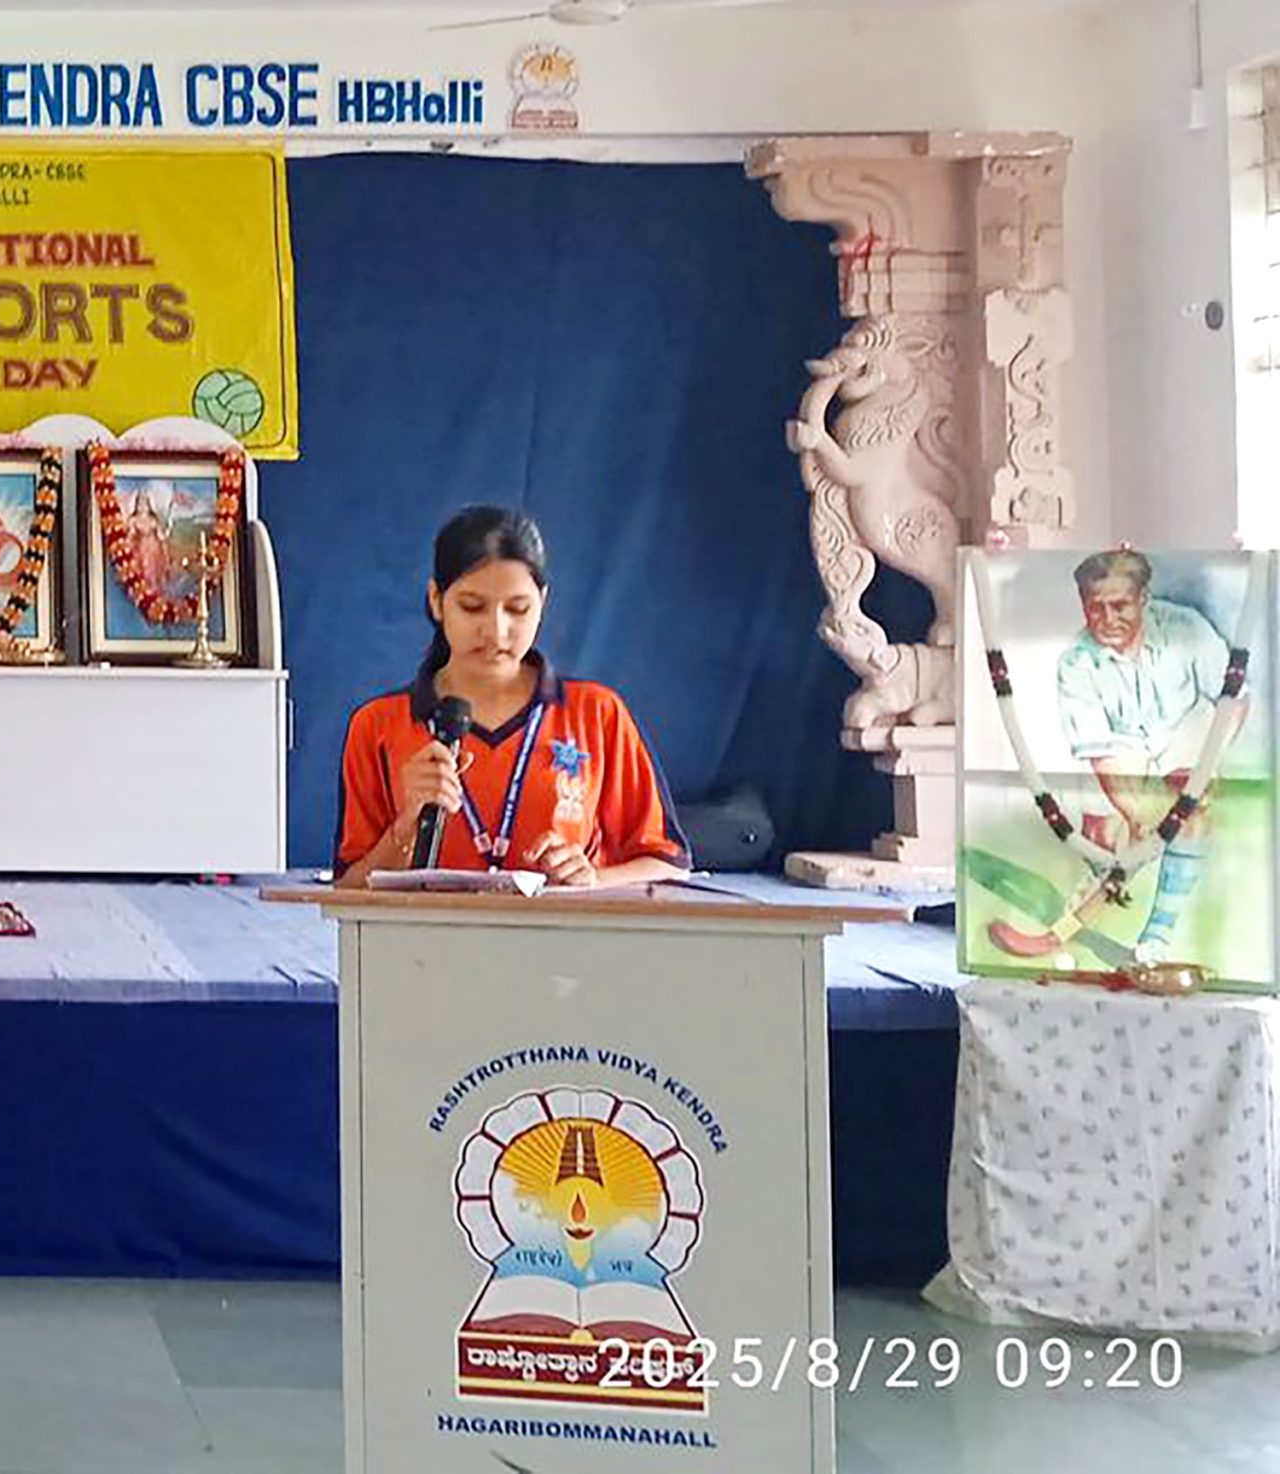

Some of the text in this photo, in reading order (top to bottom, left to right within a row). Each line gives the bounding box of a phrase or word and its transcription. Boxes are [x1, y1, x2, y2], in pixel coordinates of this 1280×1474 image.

[185, 63, 320, 128] CBSE
[337, 79, 485, 124] HBHalli
[1, 358, 98, 390] DAY
[429, 1046, 728, 1154] RASHTROTTHANA VIDYA KENDRA
[437, 1415, 718, 1449] HAGARIBOMMANAHALL
